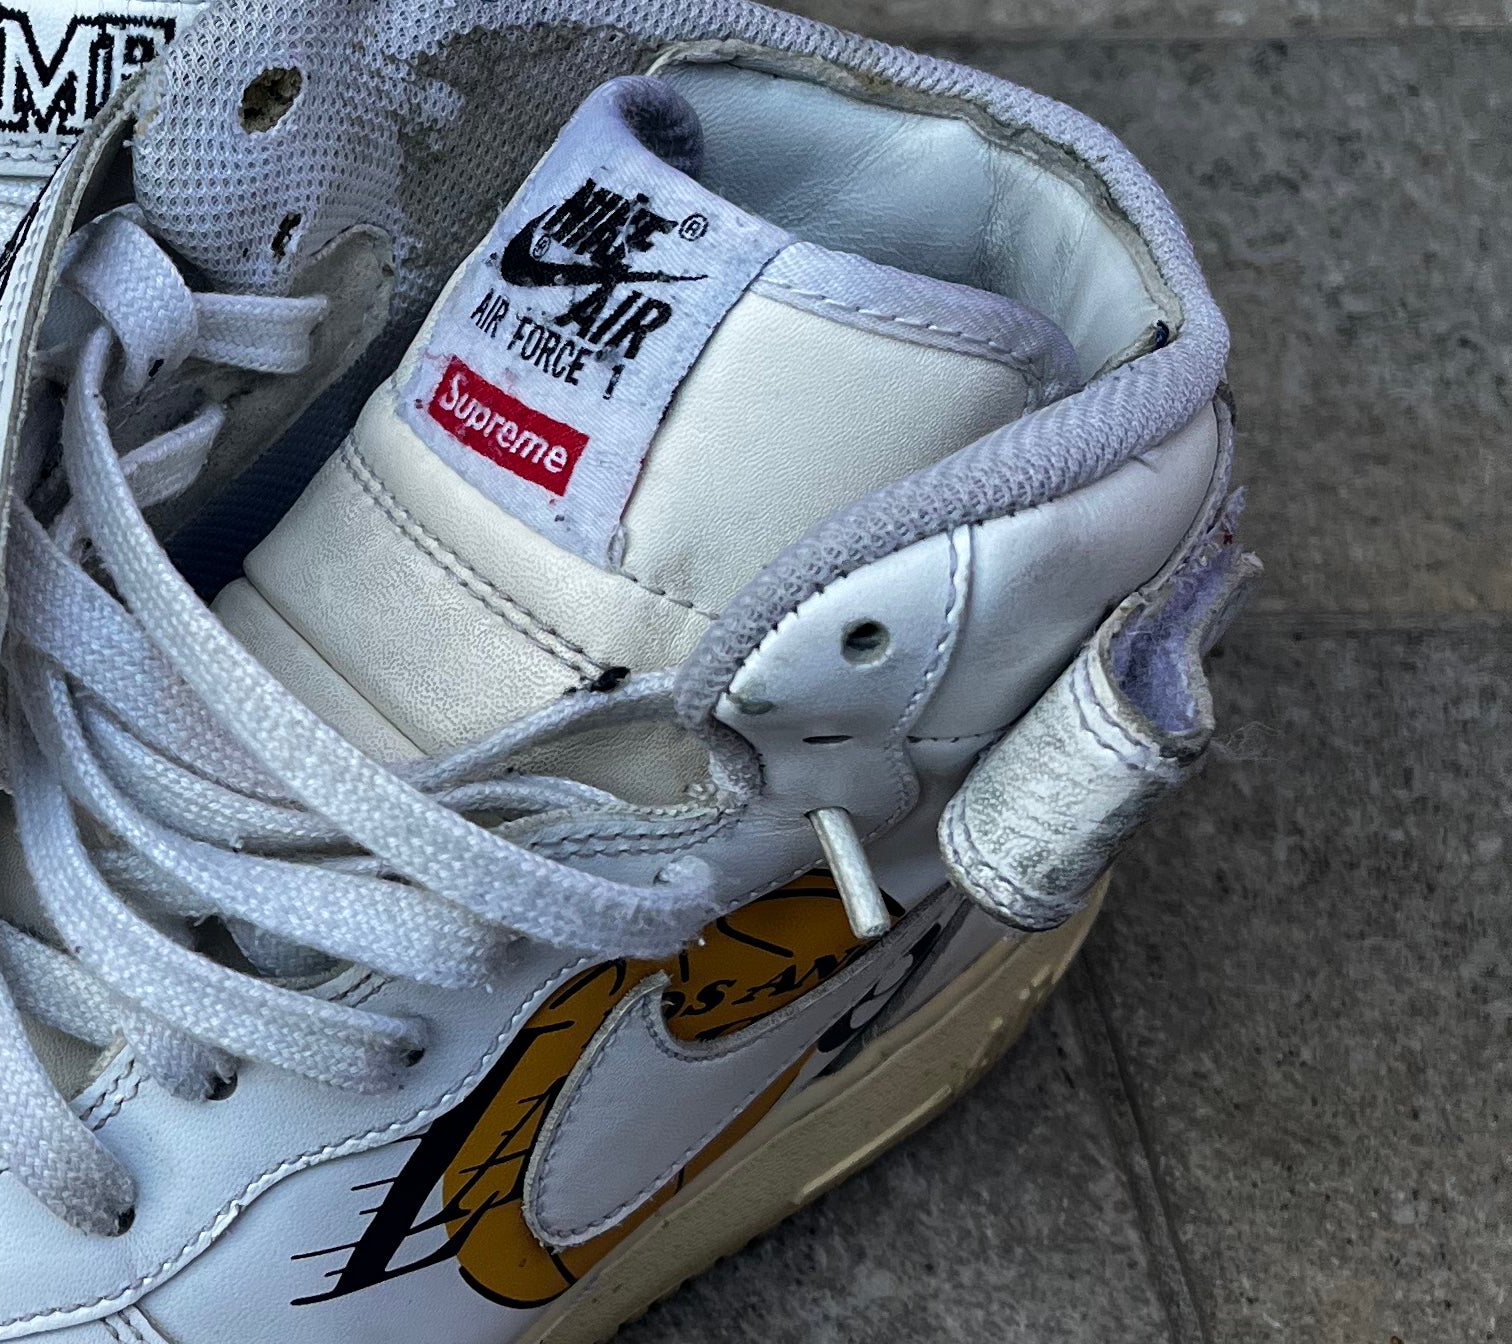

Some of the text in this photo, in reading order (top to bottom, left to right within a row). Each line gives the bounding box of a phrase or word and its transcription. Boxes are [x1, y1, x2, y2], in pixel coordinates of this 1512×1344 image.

[542, 177, 679, 258] NIKE
[470, 288, 625, 400] AIR FORCE 1
[553, 282, 672, 360] AIR
[437, 373, 569, 474] Supreme
